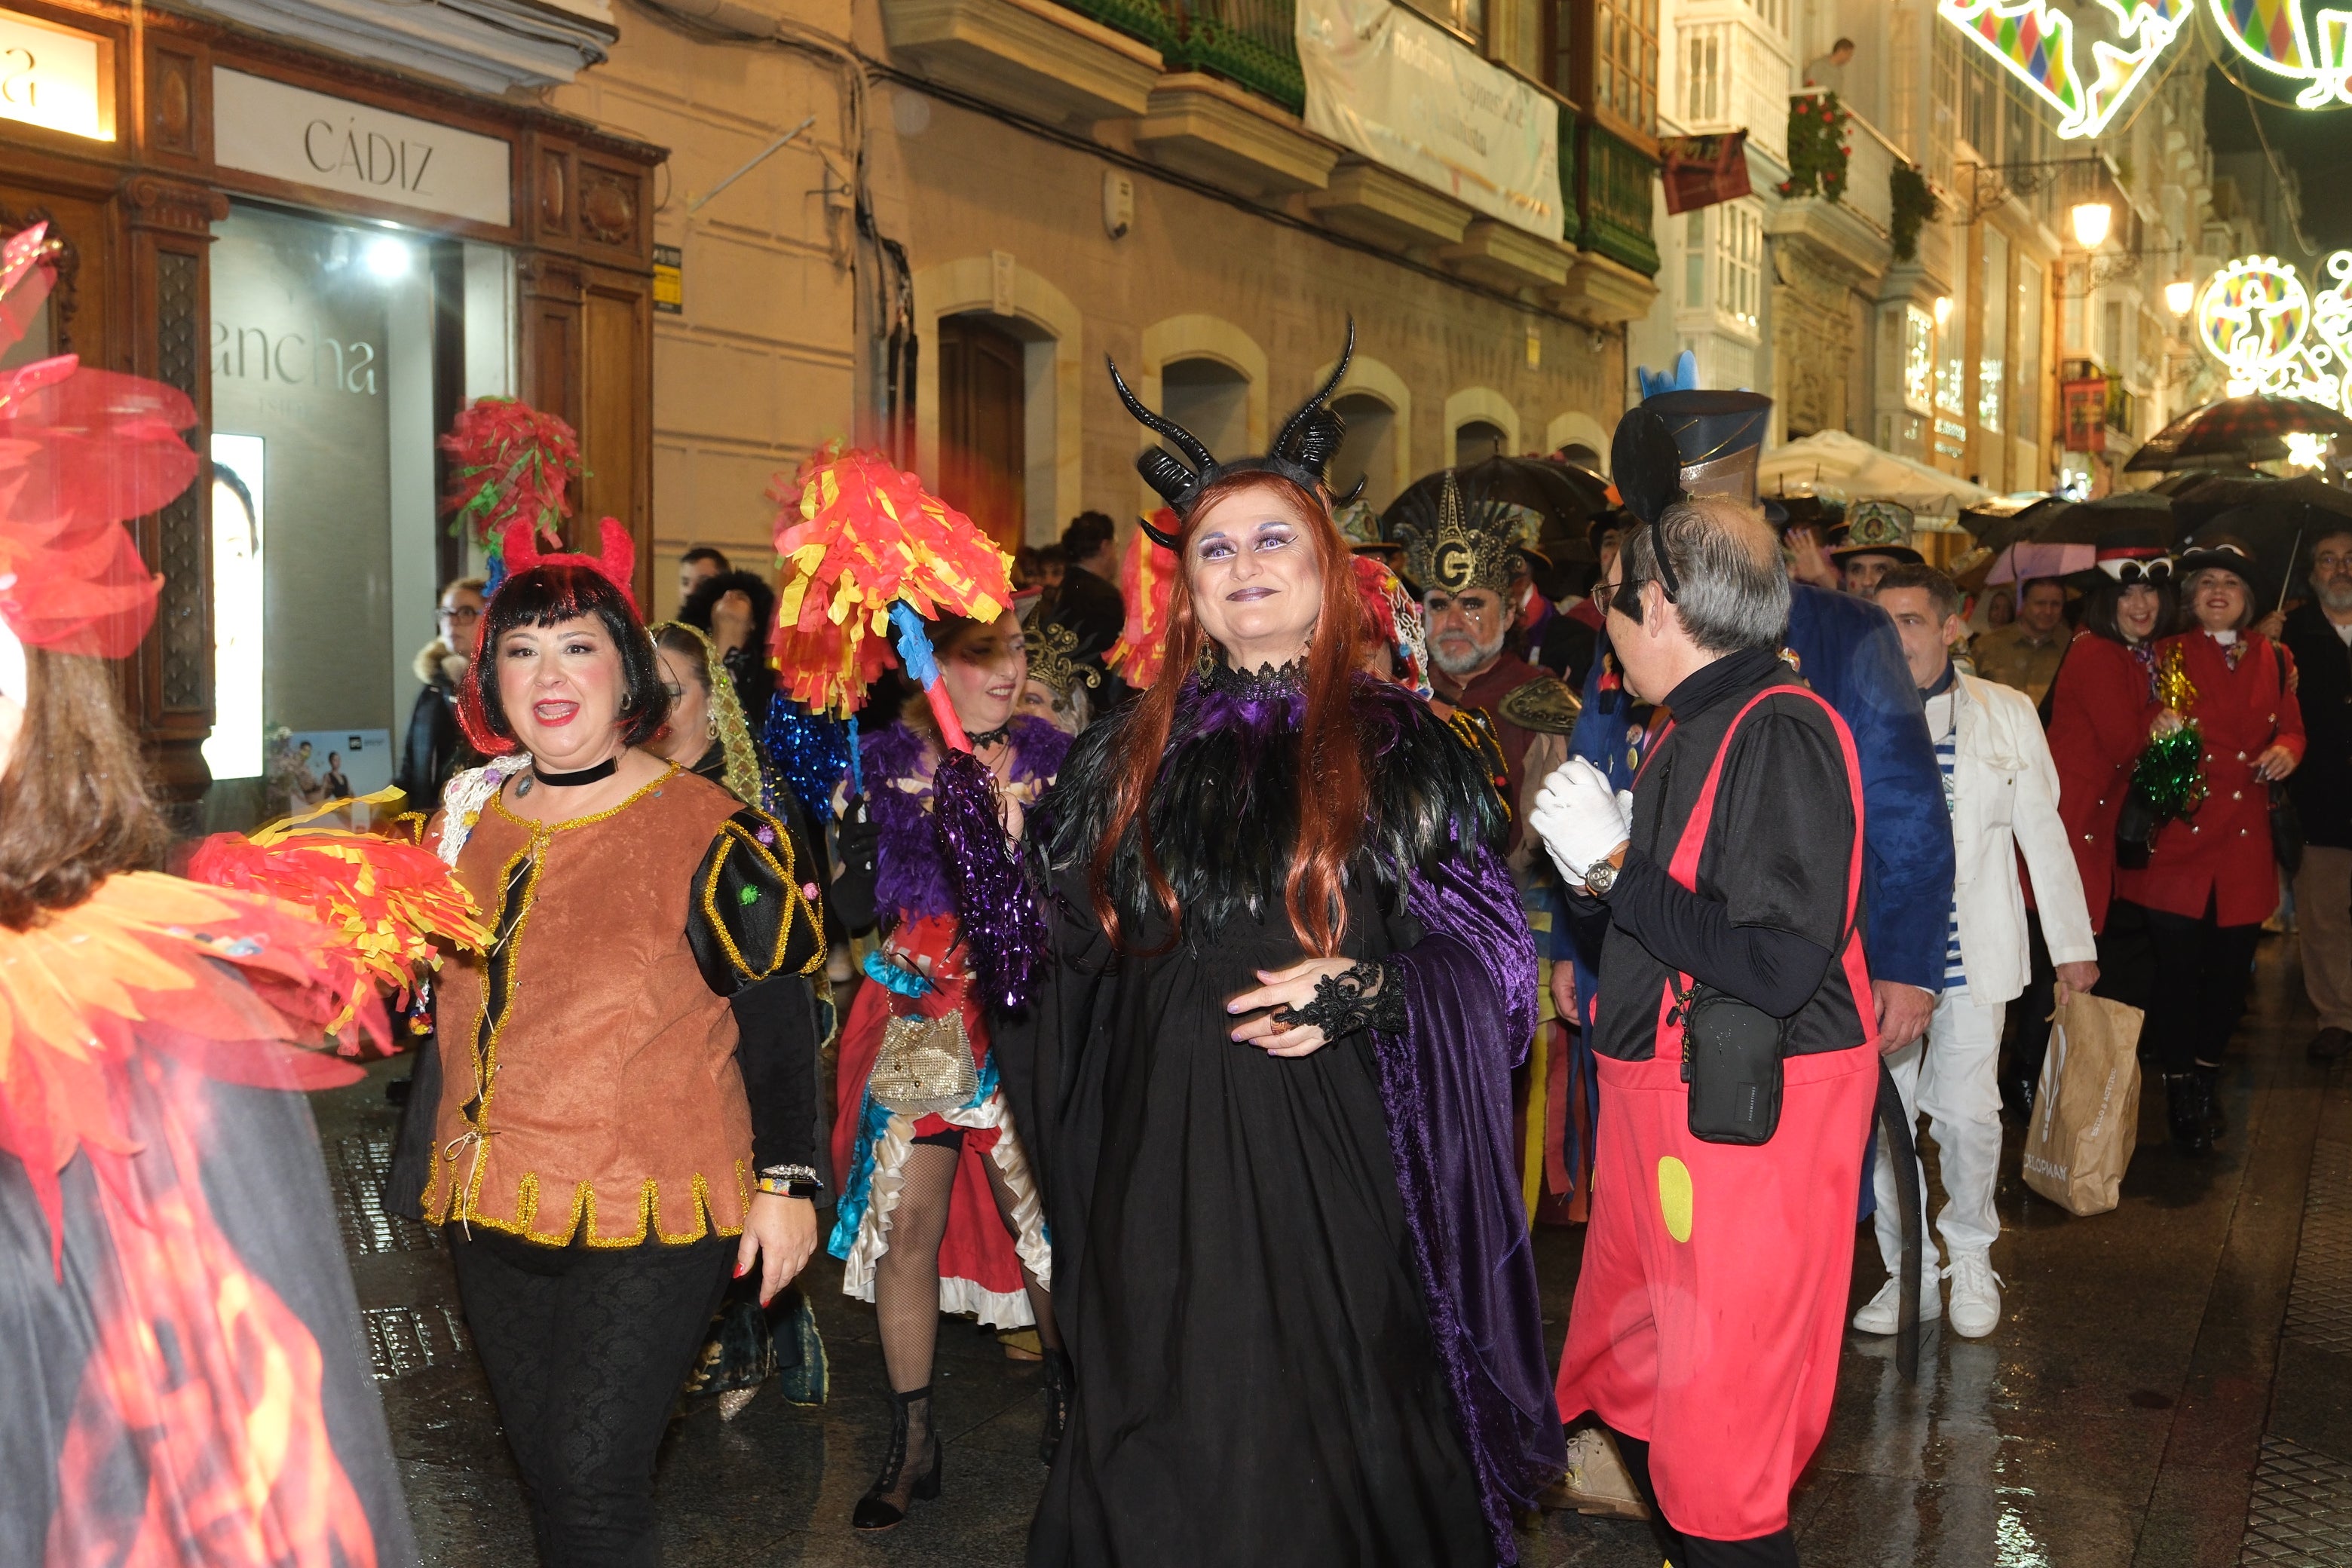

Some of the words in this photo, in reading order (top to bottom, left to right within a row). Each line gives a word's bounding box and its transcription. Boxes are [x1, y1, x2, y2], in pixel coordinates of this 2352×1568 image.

[305, 116, 433, 196] CÁDIZ
[2090, 1110, 2105, 1137] ESTILO
[2103, 1067, 2117, 1101] ACTITUD
